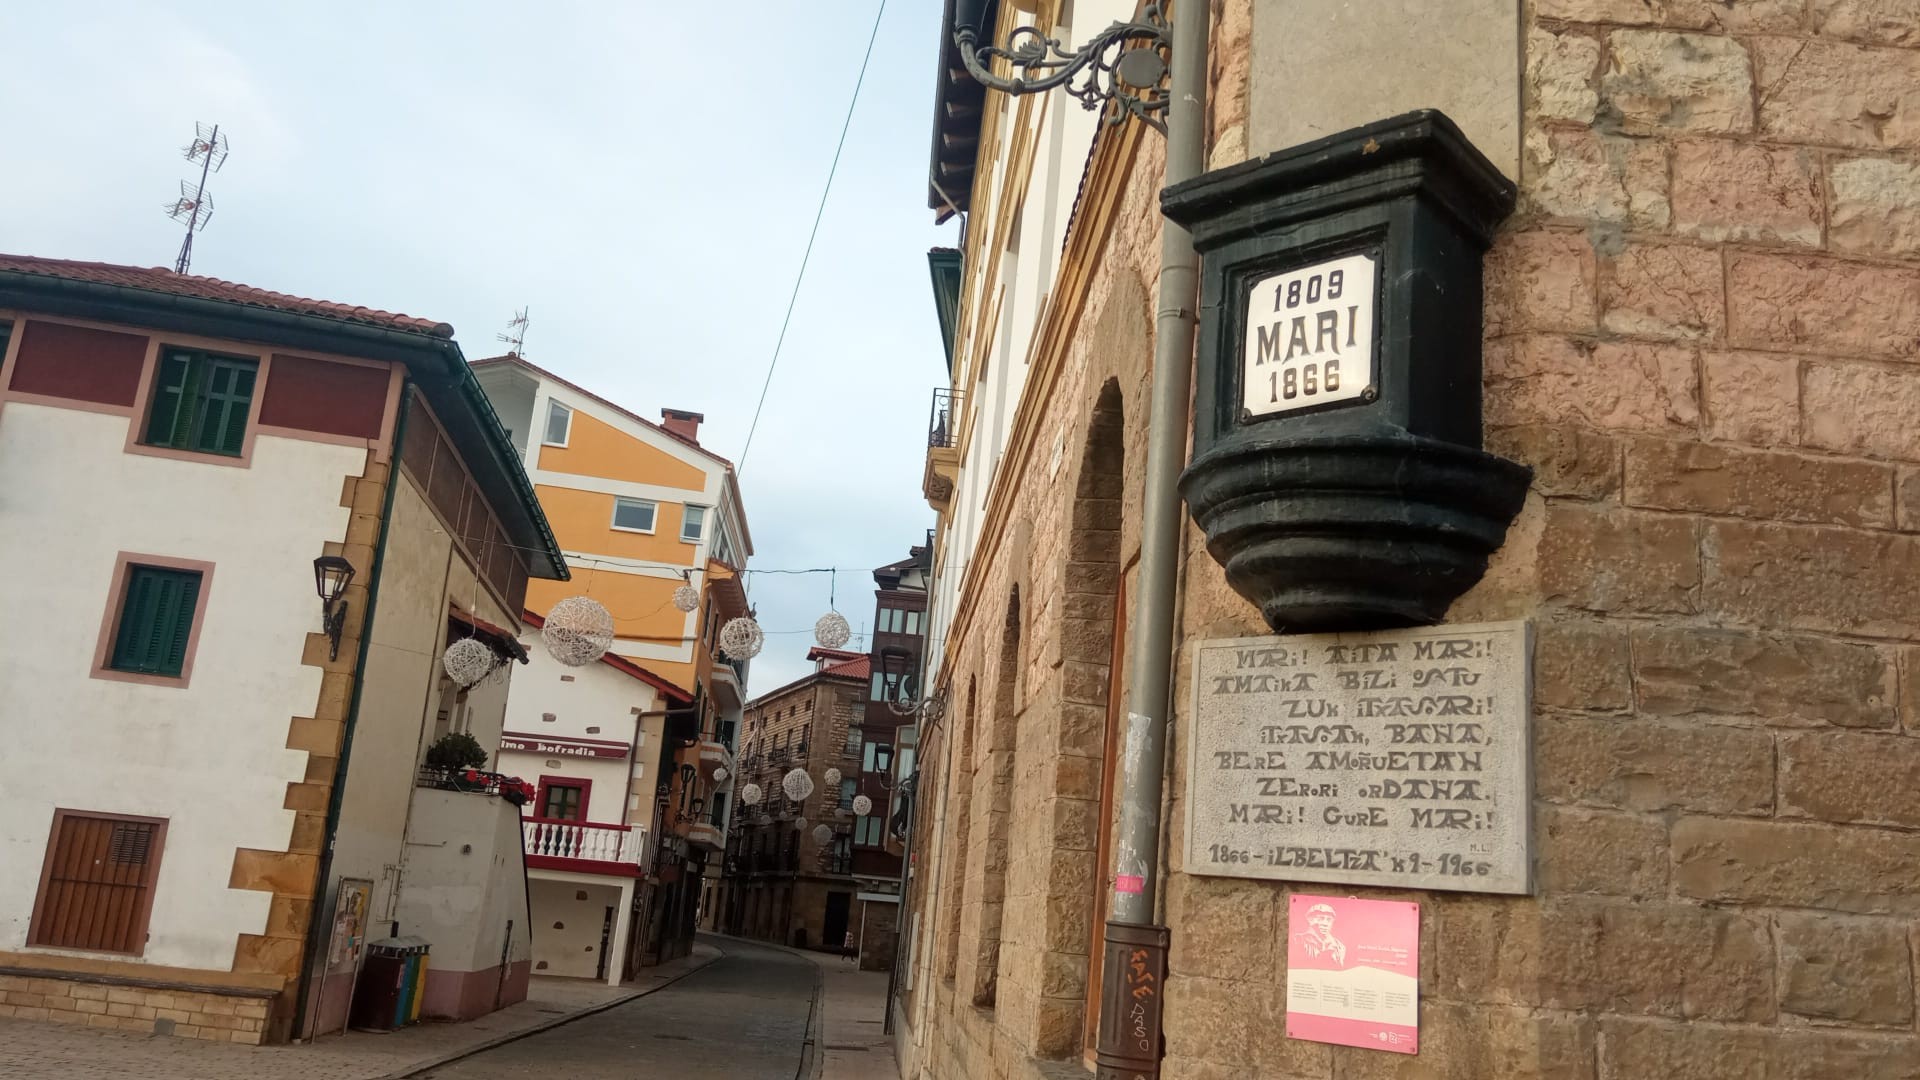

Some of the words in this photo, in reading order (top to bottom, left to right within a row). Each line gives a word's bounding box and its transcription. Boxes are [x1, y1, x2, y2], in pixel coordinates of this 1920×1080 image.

[1273, 269, 1344, 312] 1809
[1255, 305, 1359, 366] MARI
[1269, 359, 1340, 403] 1866
